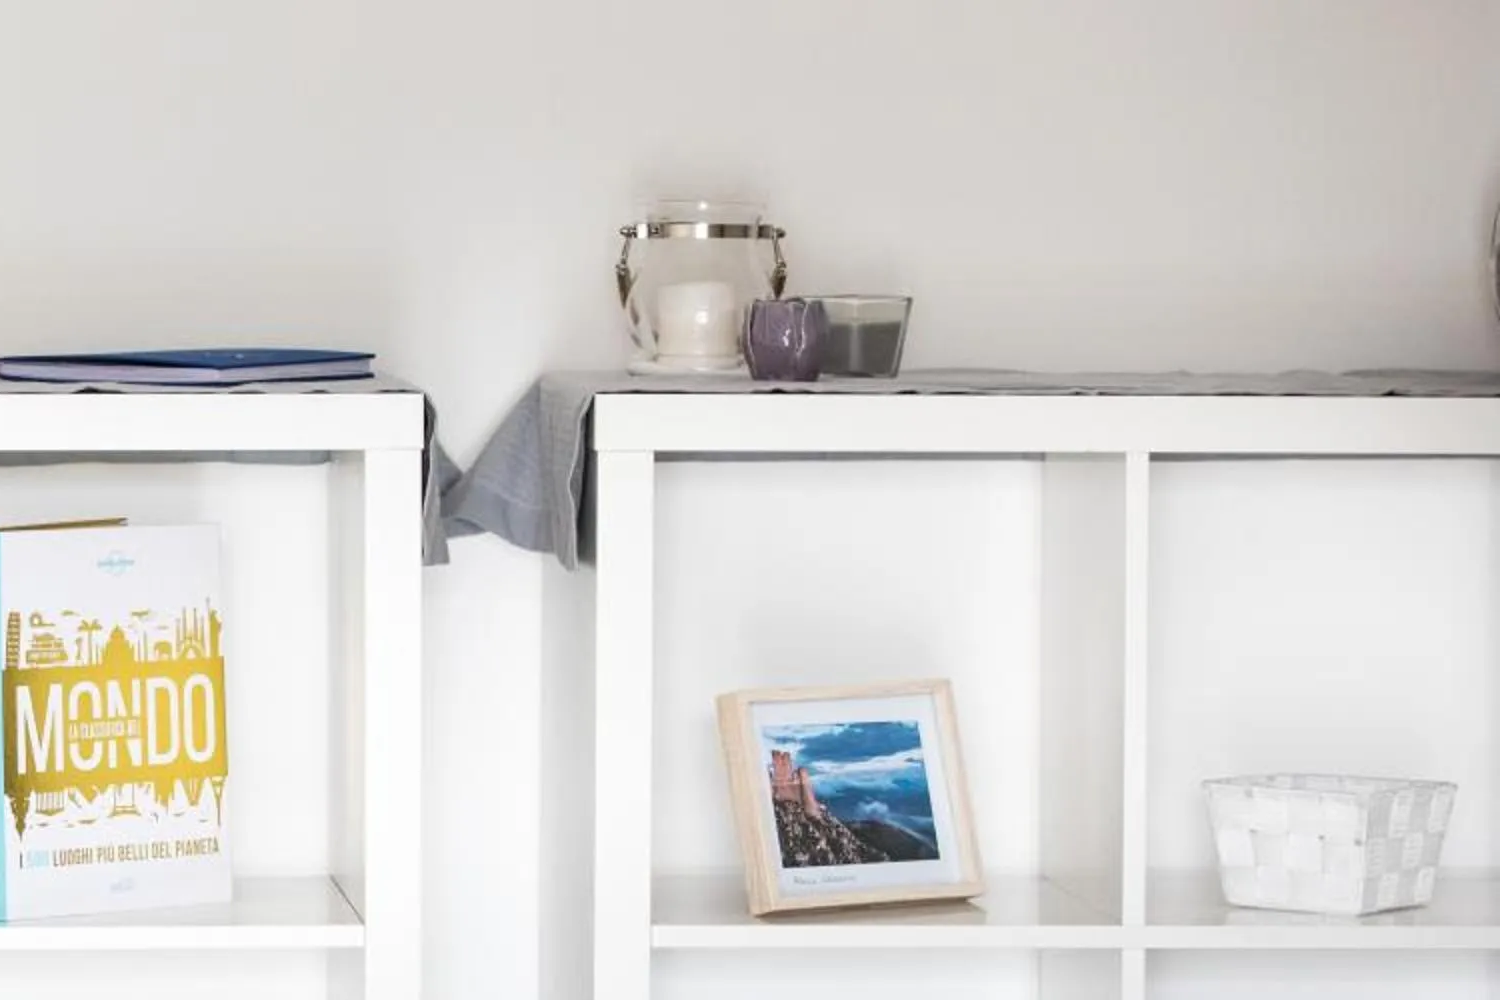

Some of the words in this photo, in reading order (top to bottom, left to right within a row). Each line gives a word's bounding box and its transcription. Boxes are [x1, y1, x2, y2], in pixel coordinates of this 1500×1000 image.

[15, 672, 217, 776] MONDO
[52, 845, 93, 868] LUOGHI
[117, 842, 149, 863] BELLI
[151, 840, 172, 860] DEL
[174, 837, 220, 859] PIANETA
